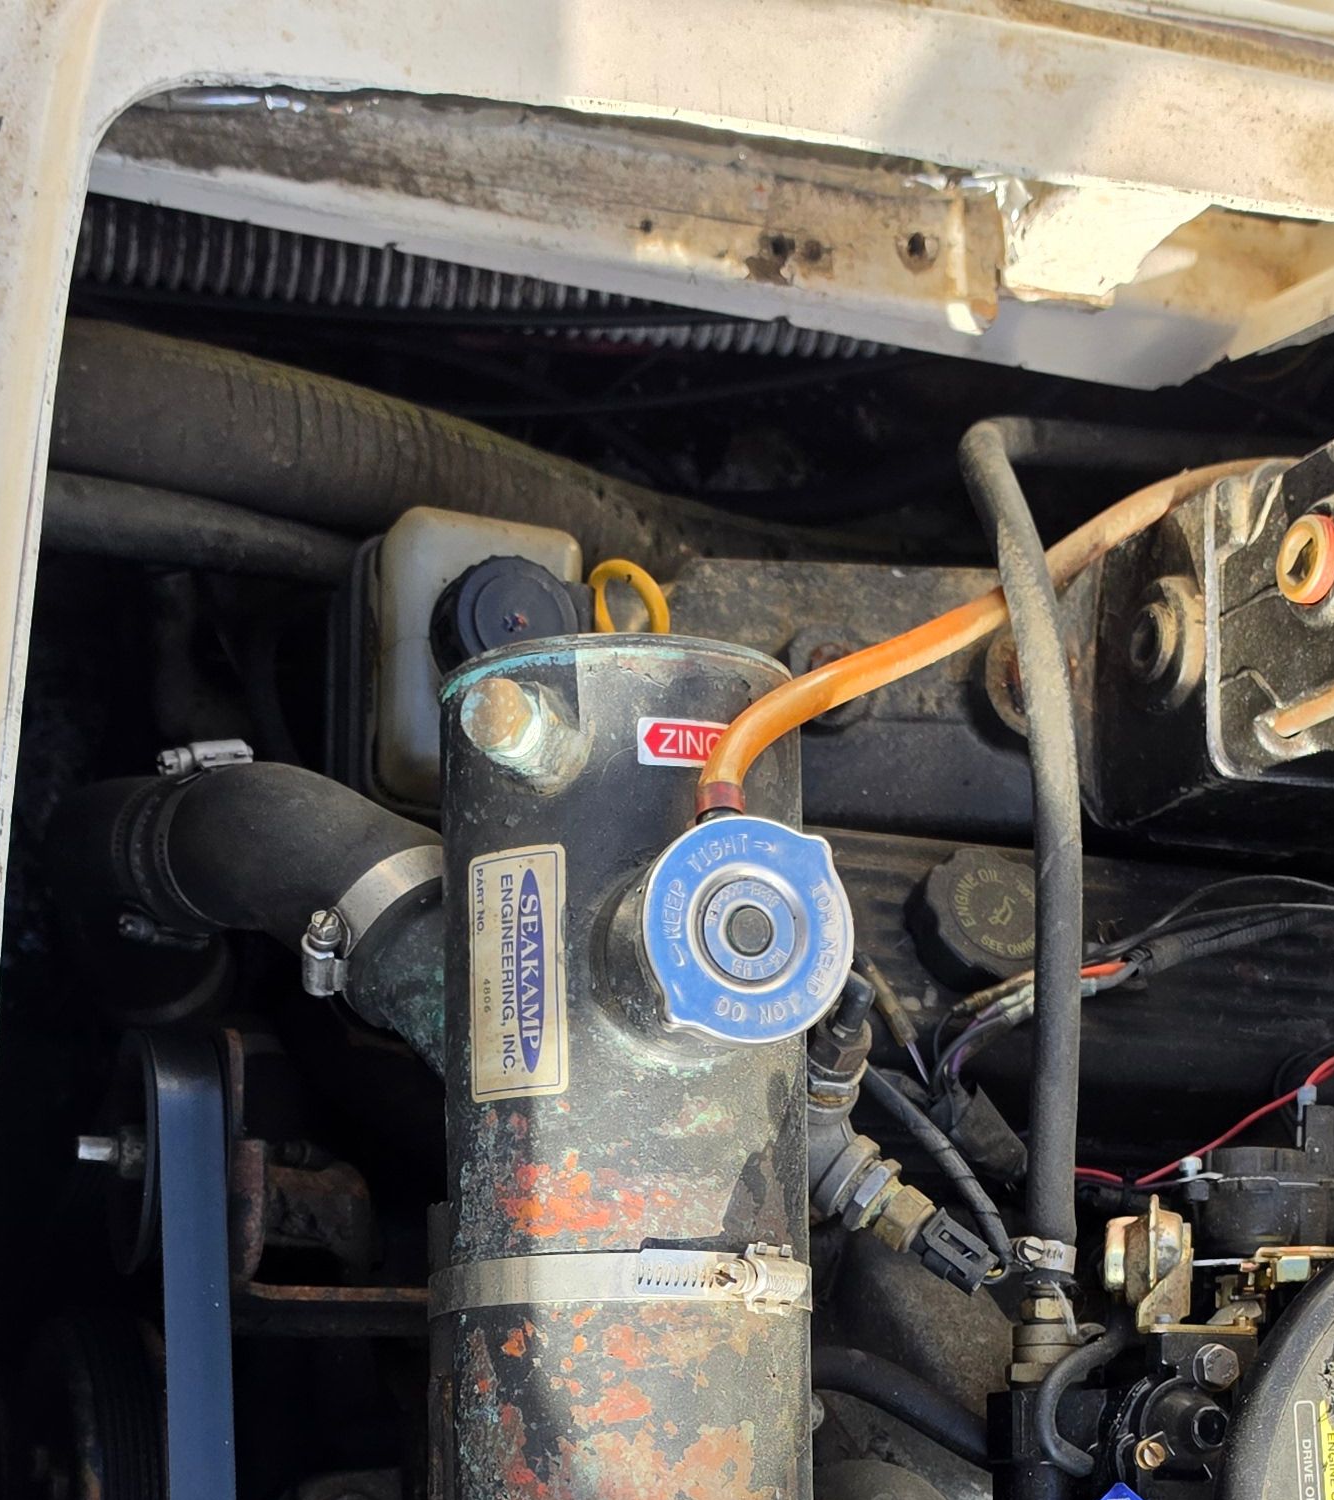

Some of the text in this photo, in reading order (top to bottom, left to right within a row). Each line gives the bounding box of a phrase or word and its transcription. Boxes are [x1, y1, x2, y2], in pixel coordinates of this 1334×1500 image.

[476, 867, 485, 935] PART NO.
[663, 879, 686, 940] KEEP
[687, 833, 749, 873] TIGHT
[954, 868, 1004, 928] ENGINE OIL
[500, 873, 515, 1075] ENGINEERING, INC.
[520, 894, 540, 1050] SEAKAMP
[980, 934, 1004, 954] SEE
[483, 978, 491, 1013] 4806
[715, 995, 747, 1022] DO
[759, 993, 802, 1025] NOT
[806, 939, 838, 996] OPEN
[1302, 1439, 1314, 1484] DRIVE
